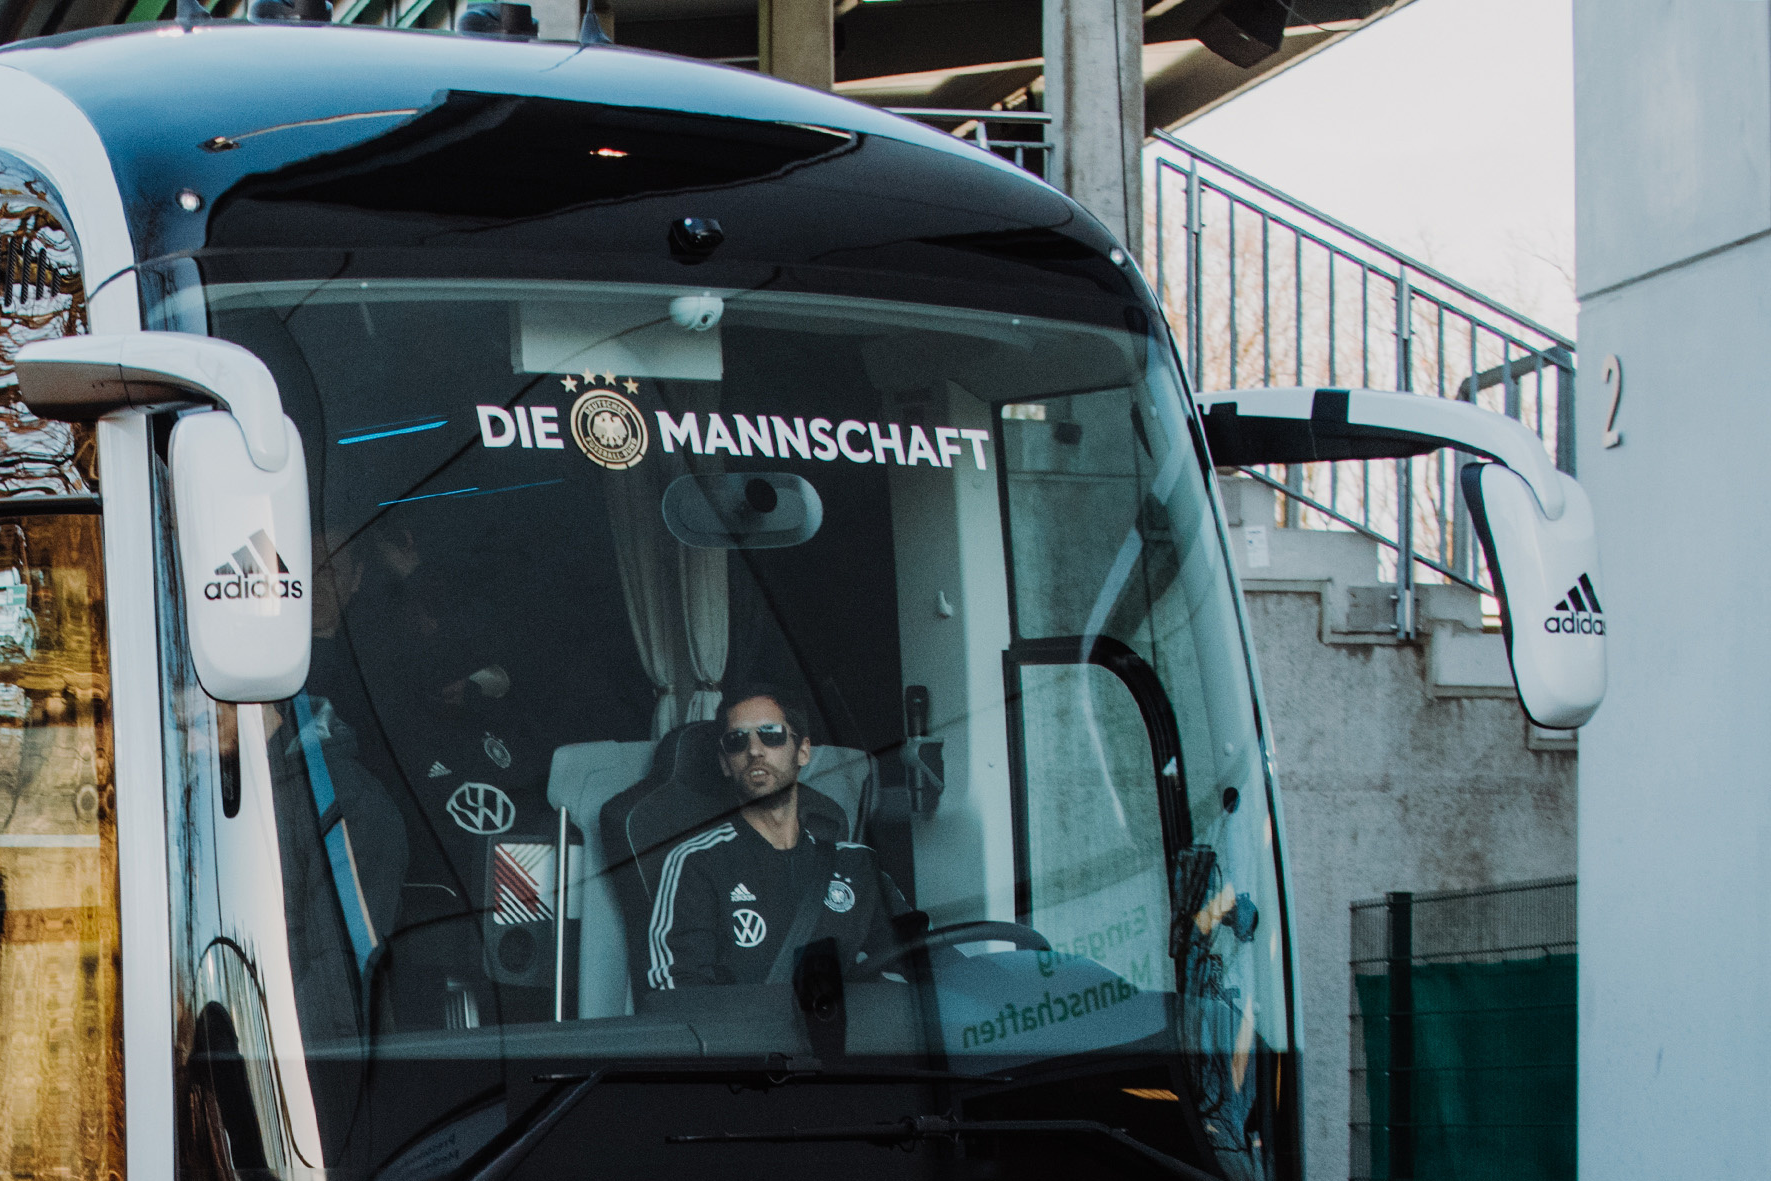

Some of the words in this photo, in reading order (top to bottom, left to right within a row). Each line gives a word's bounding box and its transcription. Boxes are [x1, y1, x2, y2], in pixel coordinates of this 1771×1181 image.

[1601, 353, 1625, 450] 2
[476, 404, 563, 450] DIE
[655, 409, 990, 471] MANNSCHAFT
[203, 575, 304, 601] adidas
